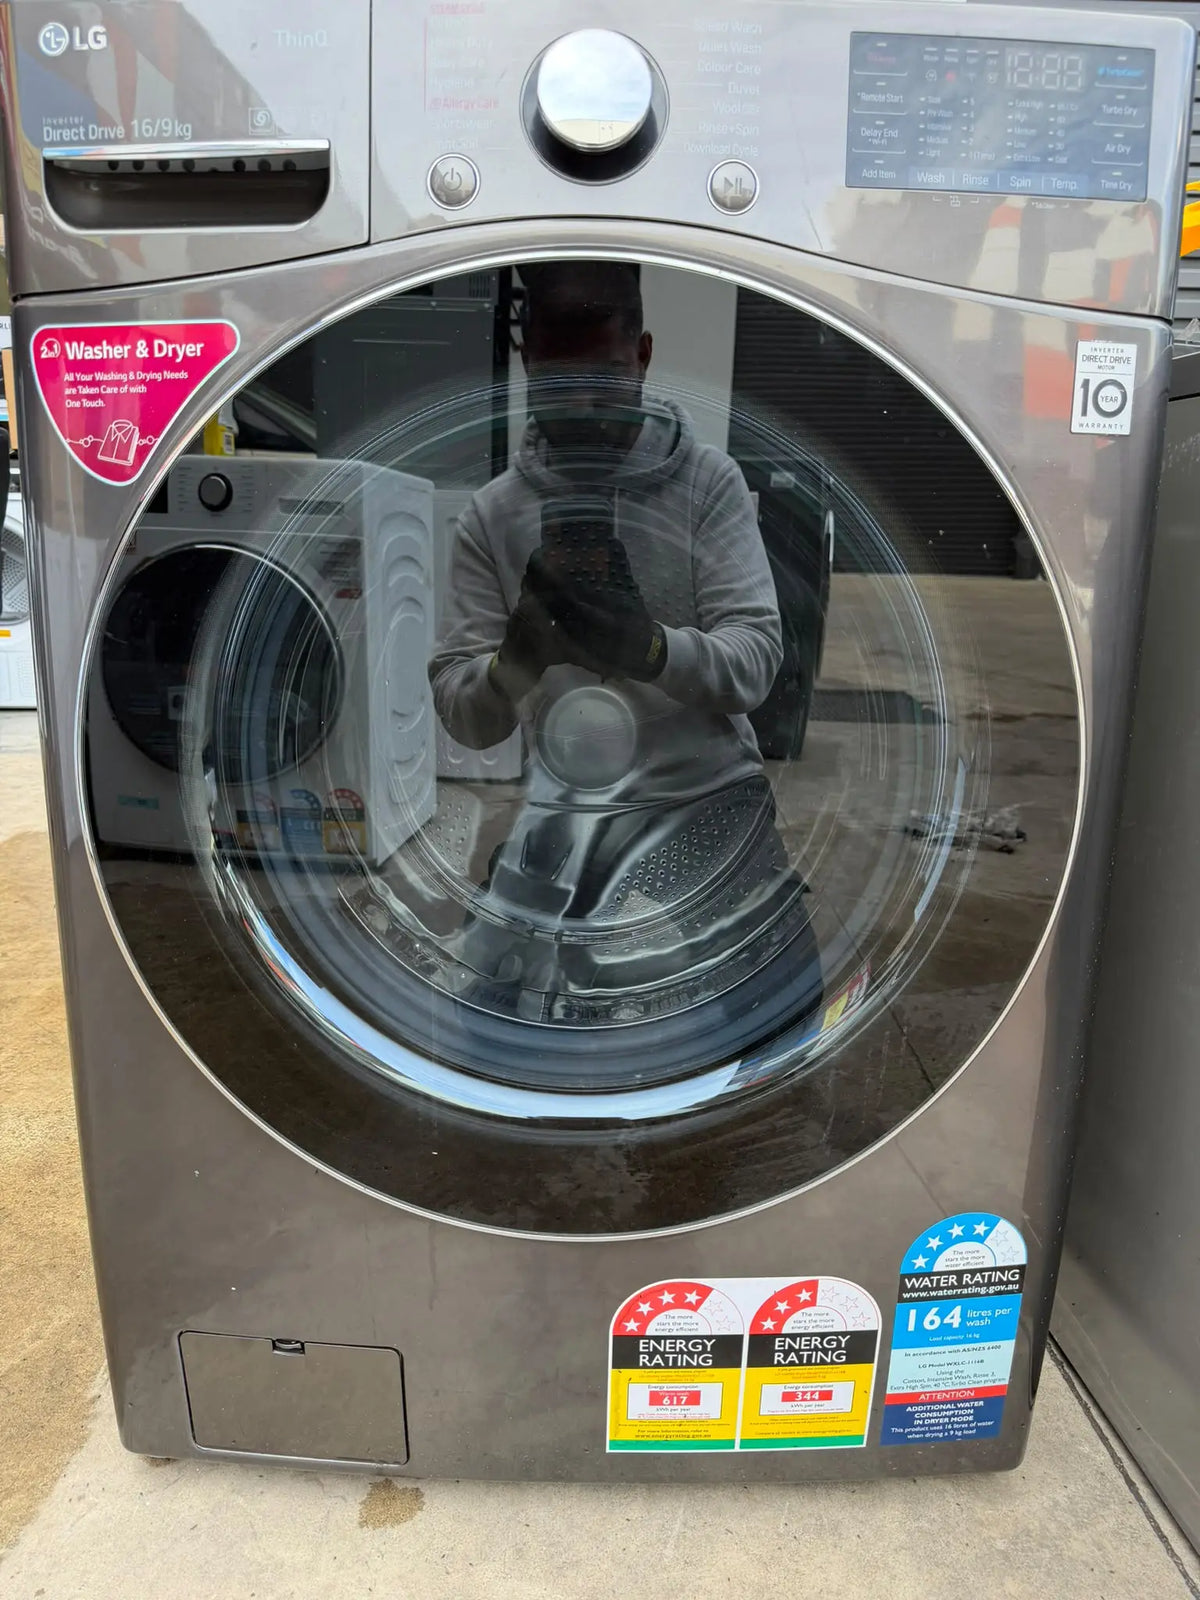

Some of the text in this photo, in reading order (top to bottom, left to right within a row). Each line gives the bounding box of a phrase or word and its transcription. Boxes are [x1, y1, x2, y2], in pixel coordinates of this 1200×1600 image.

[72, 25, 108, 51] LG
[272, 29, 329, 48] ThinQ
[731, 41, 762, 54] Wash
[697, 59, 761, 76] Colour Care
[728, 81, 760, 95] Duvet
[860, 92, 904, 103] Remote Start
[1102, 104, 1138, 117] Turbo Dry
[43, 125, 86, 142] Direct
[88, 124, 125, 139] Drive
[861, 127, 898, 138] Delay End
[684, 143, 759, 157] Download Cycle
[1105, 143, 1131, 155] Air Dry
[862, 168, 896, 179] Add Item
[916, 170, 945, 184] Wash
[962, 173, 989, 186] Rinse
[1009, 175, 1031, 189] Spin
[1051, 177, 1079, 191] Temp.
[1101, 179, 1133, 192] Time Dry
[65, 340, 131, 360] Washer
[136, 340, 149, 358] &
[153, 338, 204, 363] Dryer
[1090, 346, 1125, 354] INVERTER
[1081, 354, 1132, 365] DIRECT DRIVE
[64, 369, 189, 383] All Your Washing & Drying Needs
[65, 384, 147, 395] are Taken Care of with
[65, 398, 106, 408] One Touch.
[1080, 378, 1128, 419] 10
[1100, 395, 1119, 404] YEAR
[1078, 421, 1124, 430] WARRANTY
[904, 1269, 1020, 1289] WATER RATING
[902, 1282, 1020, 1299] www.waterrating.gov.au
[906, 1304, 962, 1332] 164
[967, 1307, 1013, 1318] litres per
[966, 1317, 991, 1328] wash
[639, 1338, 717, 1353] ENERGY
[774, 1334, 851, 1351] ENERGY
[638, 1353, 714, 1367] RATING
[773, 1350, 847, 1366] RATING
[890, 1383, 905, 1391] Extra
[905, 1383, 919, 1391] High
[967, 1378, 984, 1386] Clean
[926, 1375, 954, 1383] Intensive
[662, 1395, 688, 1406] 617
[794, 1390, 820, 1401] 344
[918, 1389, 975, 1402] ATTENTION
[906, 1400, 985, 1412] ADDITIONAL WATER
[914, 1408, 974, 1419] CONSUMPTION
[924, 1417, 950, 1425] DRYER
[950, 1415, 974, 1423] MODE
[904, 1425, 929, 1434] product
[969, 1420, 977, 1428] of
[977, 1419, 995, 1427] water
[907, 1432, 924, 1440] when
[924, 1431, 944, 1439] drying
[954, 1429, 963, 1438] kg
[963, 1427, 977, 1435] load
